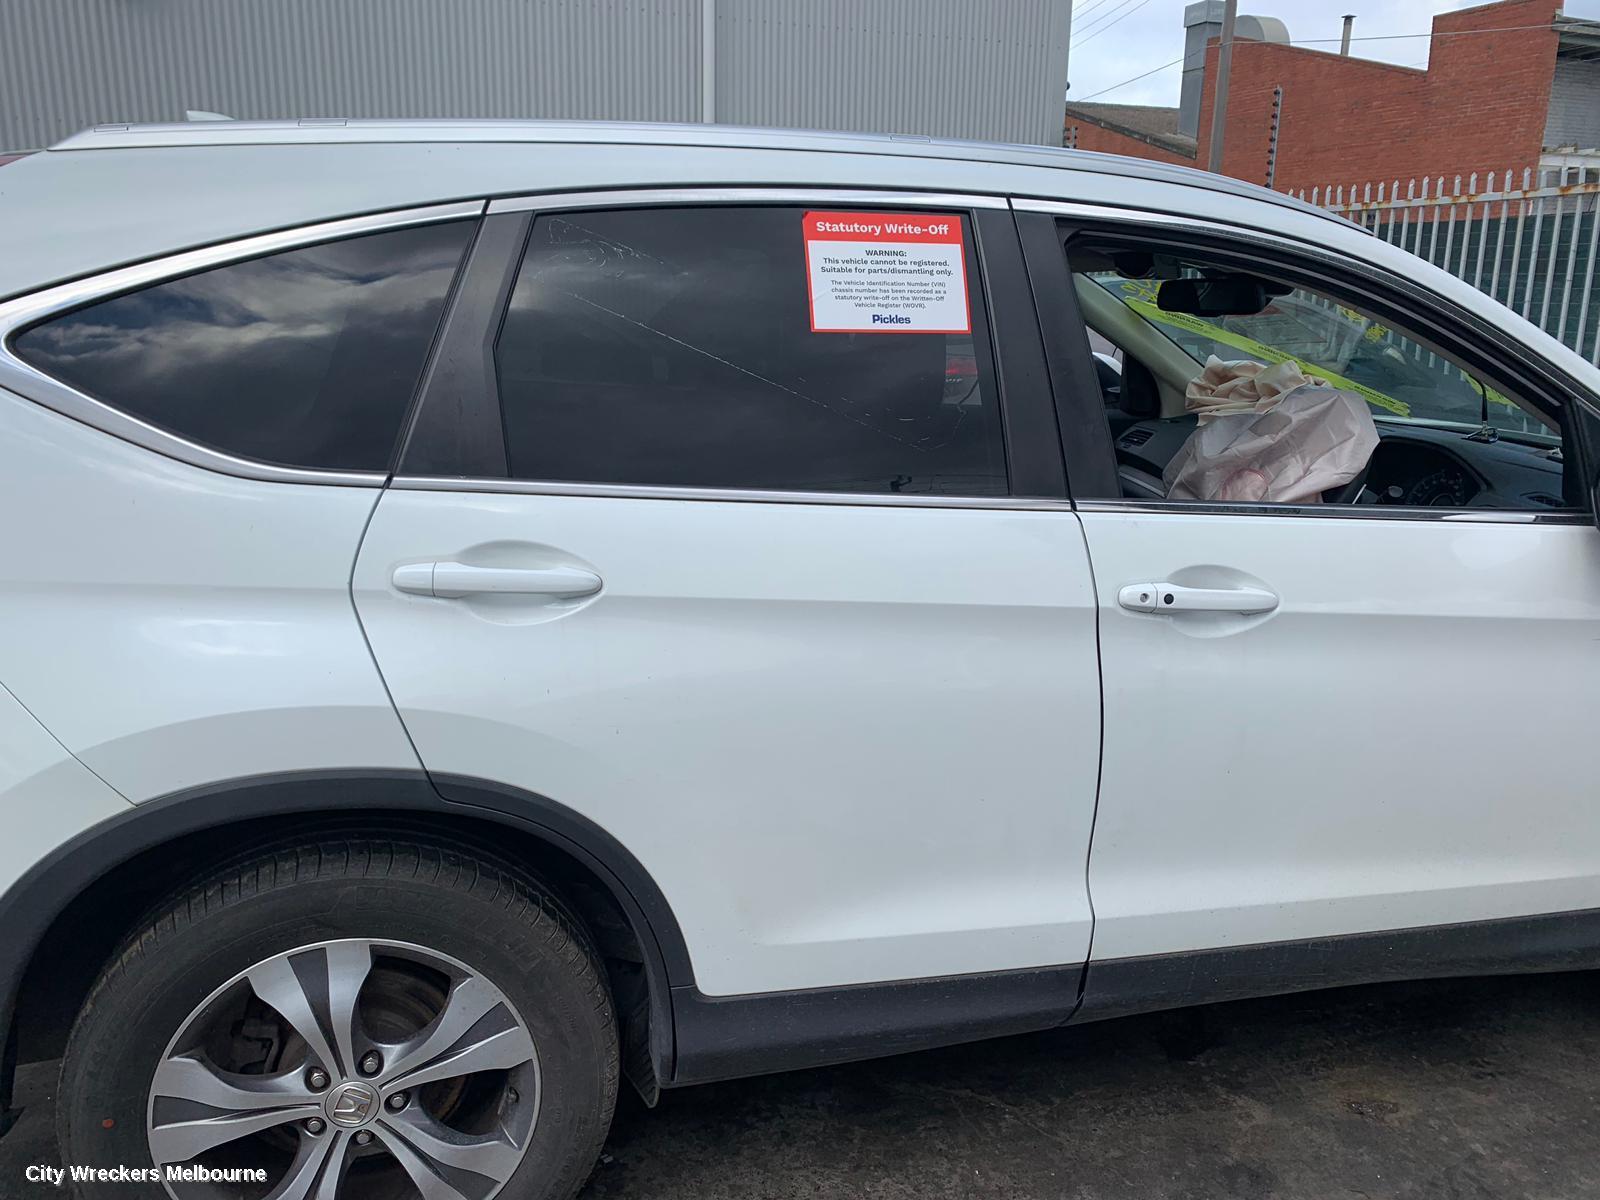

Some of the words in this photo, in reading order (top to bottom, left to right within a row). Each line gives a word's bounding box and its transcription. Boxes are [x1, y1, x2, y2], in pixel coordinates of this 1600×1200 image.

[816, 222, 881, 235] Statutory
[884, 224, 949, 235] Write-Off
[867, 268, 934, 276] parts/dismantling
[872, 314, 911, 324] Pickles
